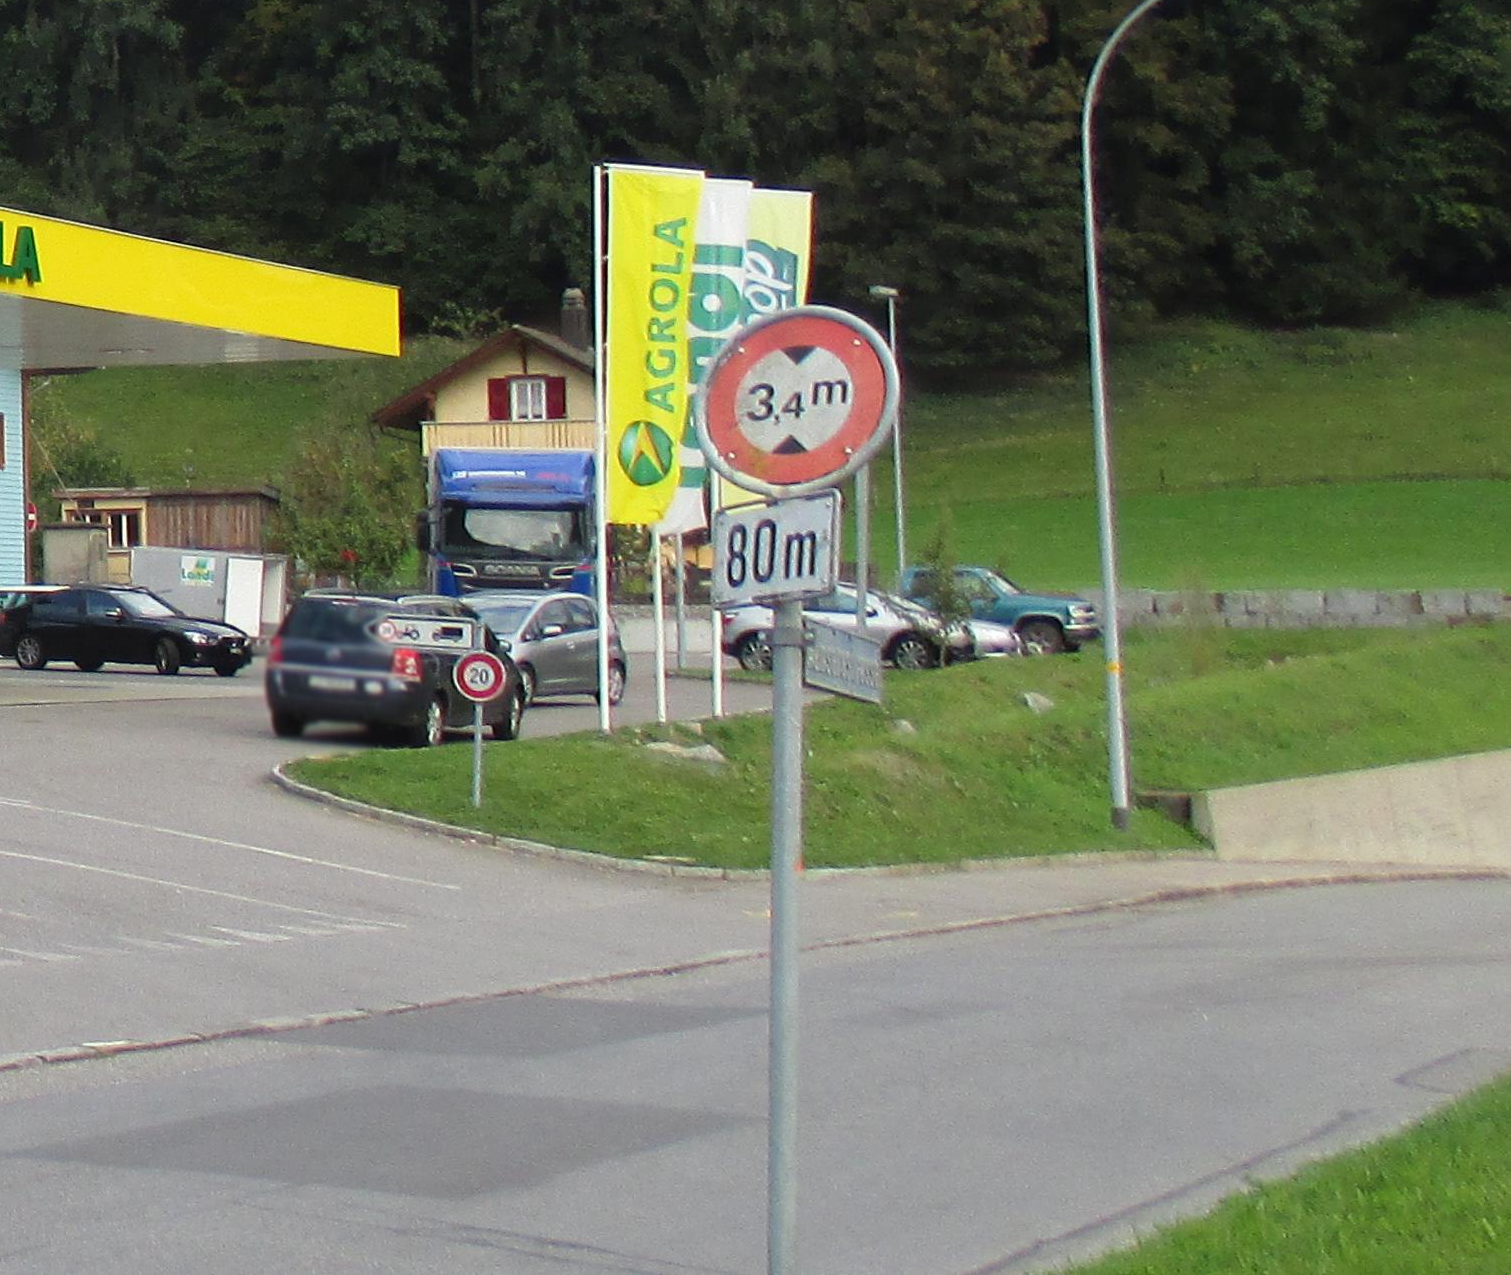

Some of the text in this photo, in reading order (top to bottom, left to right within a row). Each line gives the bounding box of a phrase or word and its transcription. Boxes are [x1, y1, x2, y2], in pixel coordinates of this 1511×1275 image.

[644, 216, 688, 414] AGROLA
[811, 379, 848, 406] m
[727, 518, 817, 588] 80 m
[469, 667, 490, 684] 20
